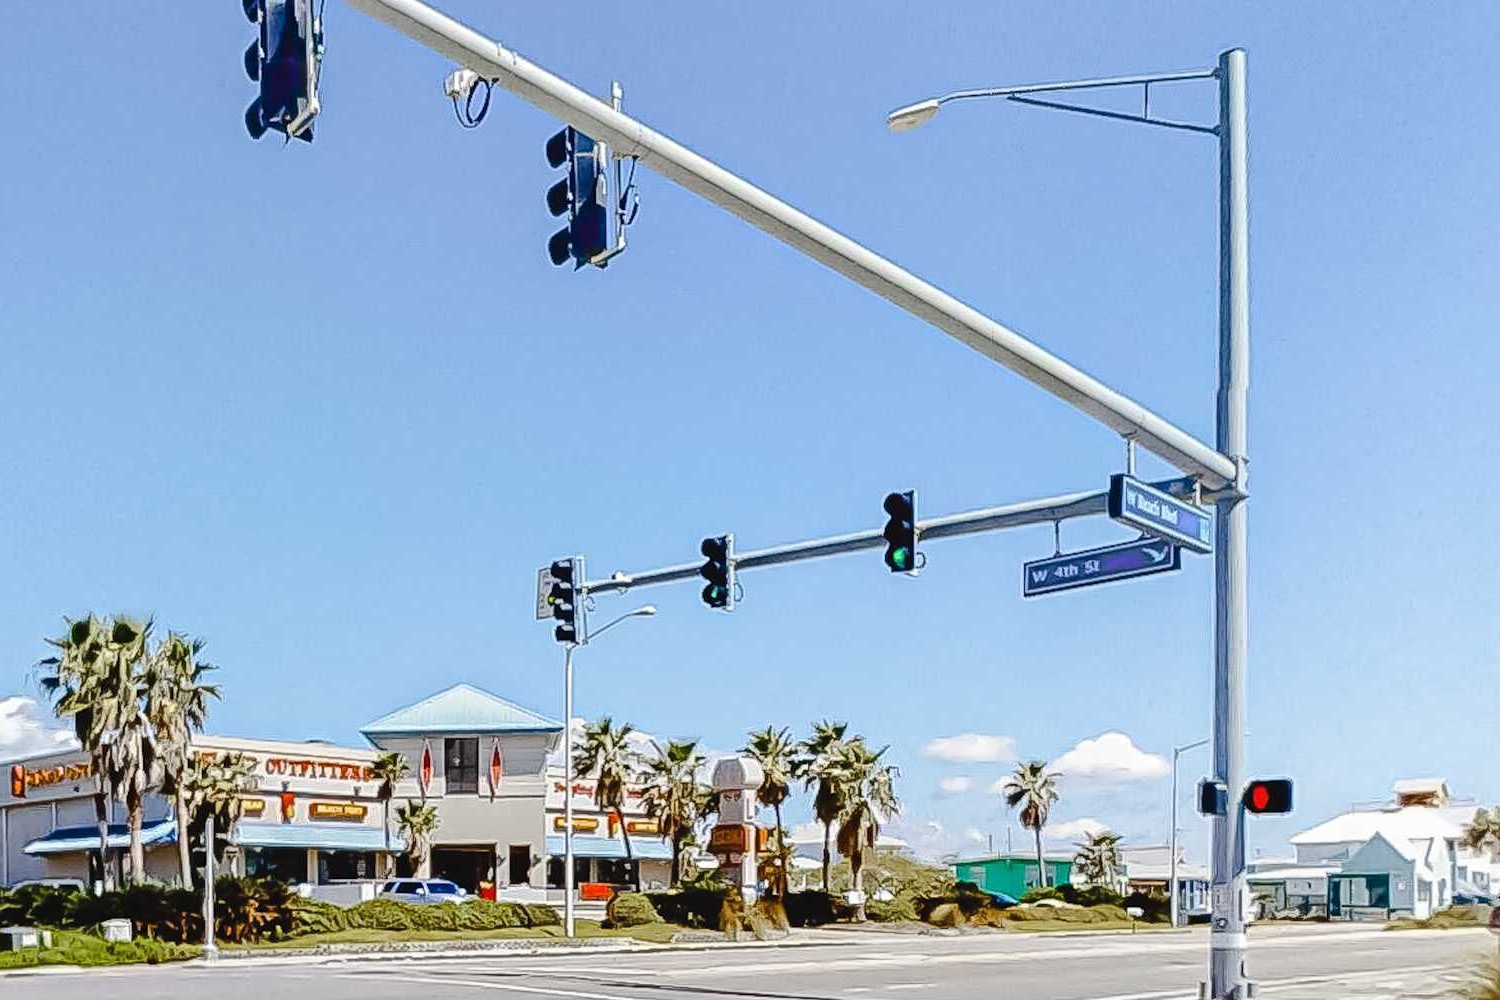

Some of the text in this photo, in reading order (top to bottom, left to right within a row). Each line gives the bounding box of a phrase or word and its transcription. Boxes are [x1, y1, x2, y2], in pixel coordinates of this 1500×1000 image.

[1032, 560, 1100, 583] W 4th St
